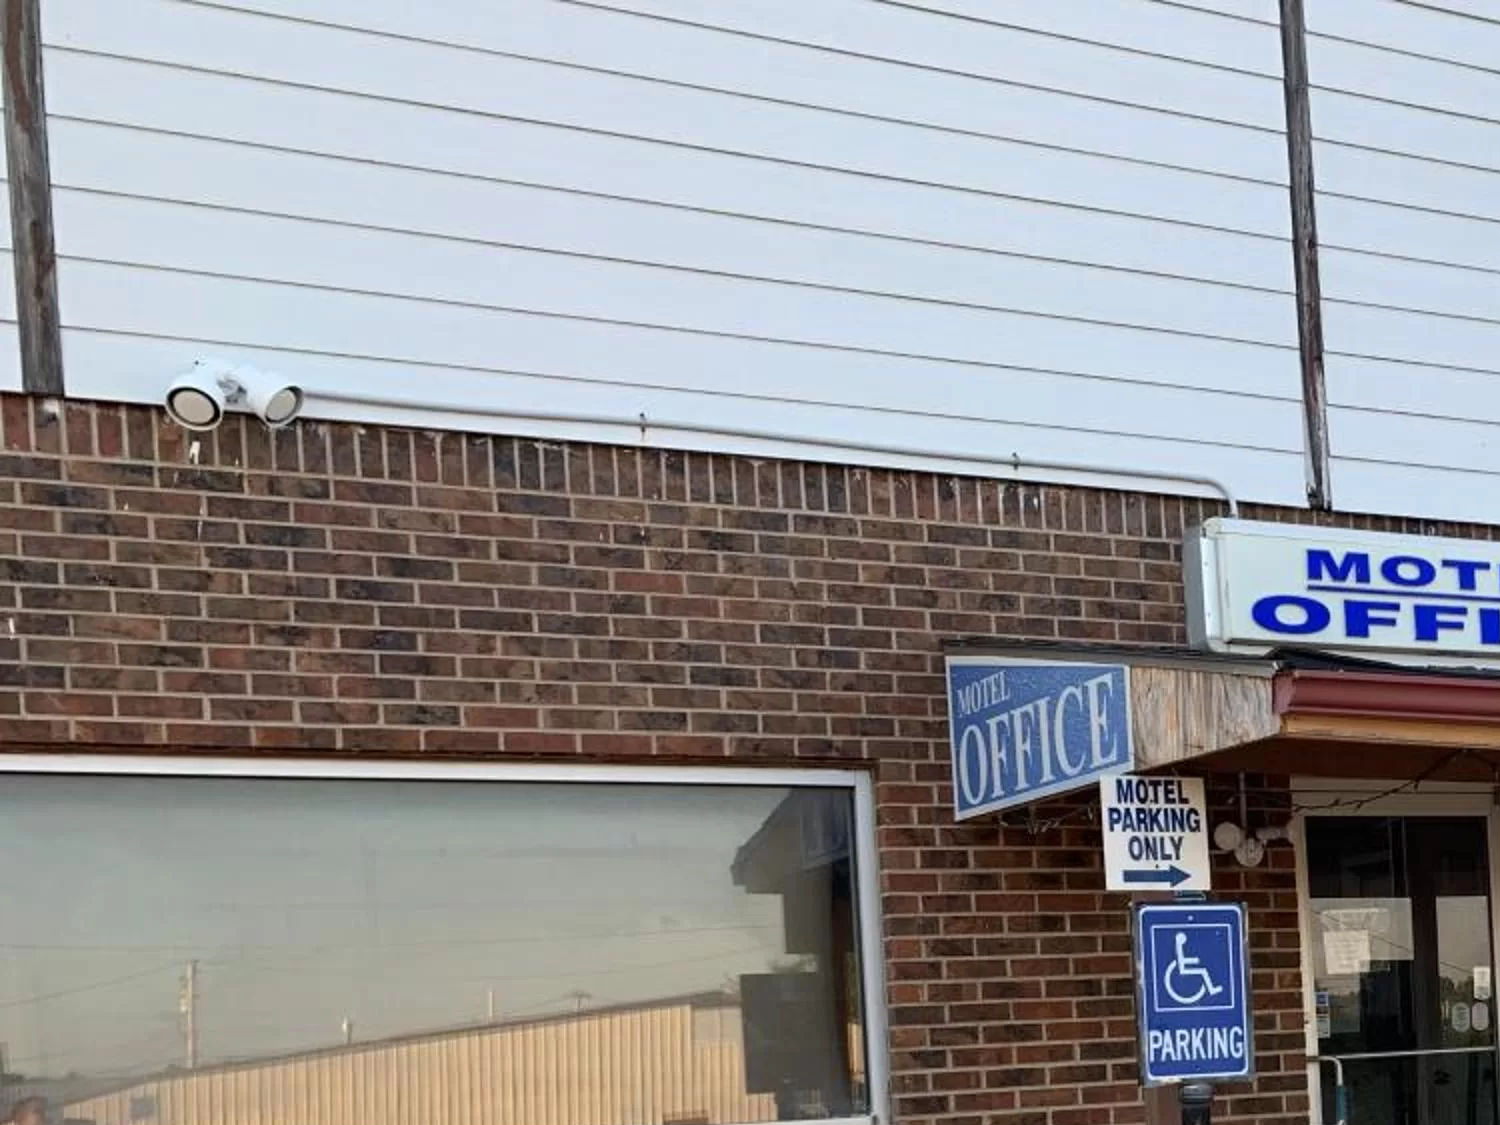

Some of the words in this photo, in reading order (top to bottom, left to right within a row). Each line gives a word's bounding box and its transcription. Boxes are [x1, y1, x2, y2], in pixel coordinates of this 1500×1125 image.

[958, 672, 1010, 717] MOTEL
[960, 673, 1117, 804] OFFICE
[1115, 778, 1190, 805] MOTEL
[1107, 807, 1201, 833] PARKING
[1127, 835, 1185, 862] ONLY
[1150, 1027, 1244, 1061] PARKING
